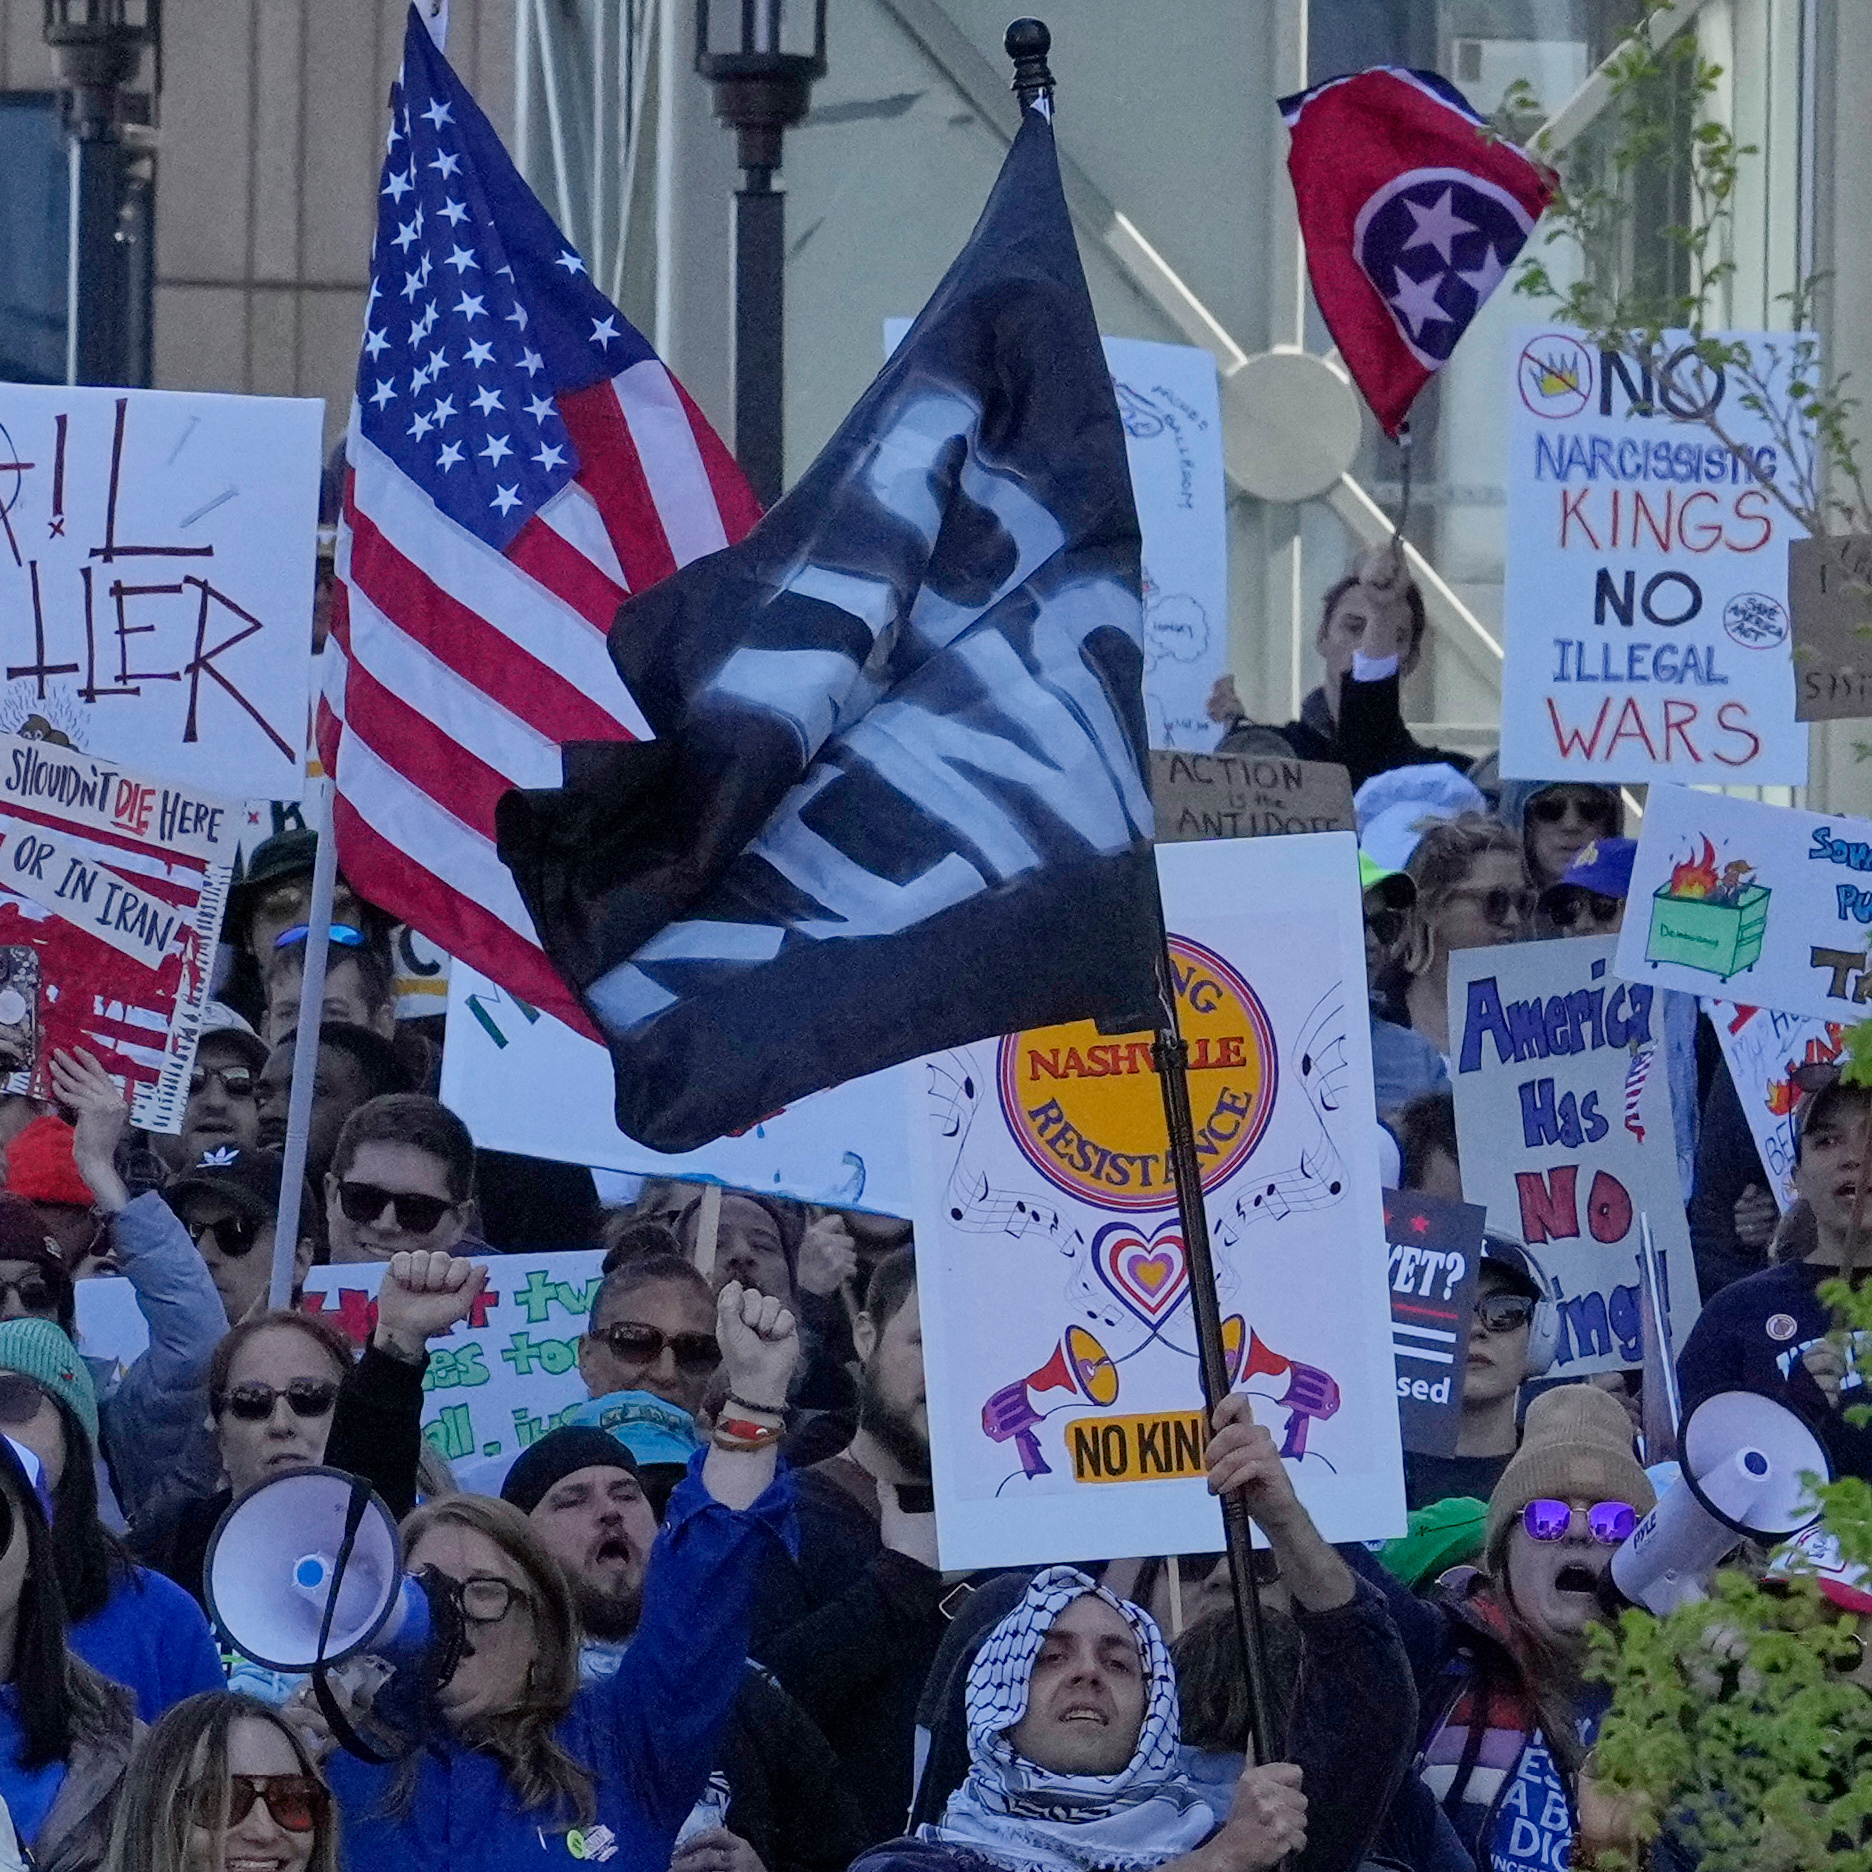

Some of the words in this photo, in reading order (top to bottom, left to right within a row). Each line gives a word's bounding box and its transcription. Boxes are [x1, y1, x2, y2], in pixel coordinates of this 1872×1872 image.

[1599, 345, 1727, 420] NO
[1559, 488, 1773, 554] KINGS
[1591, 568, 1703, 627] NO
[1552, 641, 1730, 685] ILLEGAL
[1547, 696, 1762, 768] WARS
[114, 779, 154, 829] DIE
[159, 790, 225, 845] HERE
[13, 834, 58, 880] OR
[54, 856, 96, 903] IN
[95, 881, 178, 954] IRAN
[1517, 1075, 1608, 1150] Has
[1514, 1164, 1633, 1245] NO
[1073, 1424, 1131, 1478] NO
